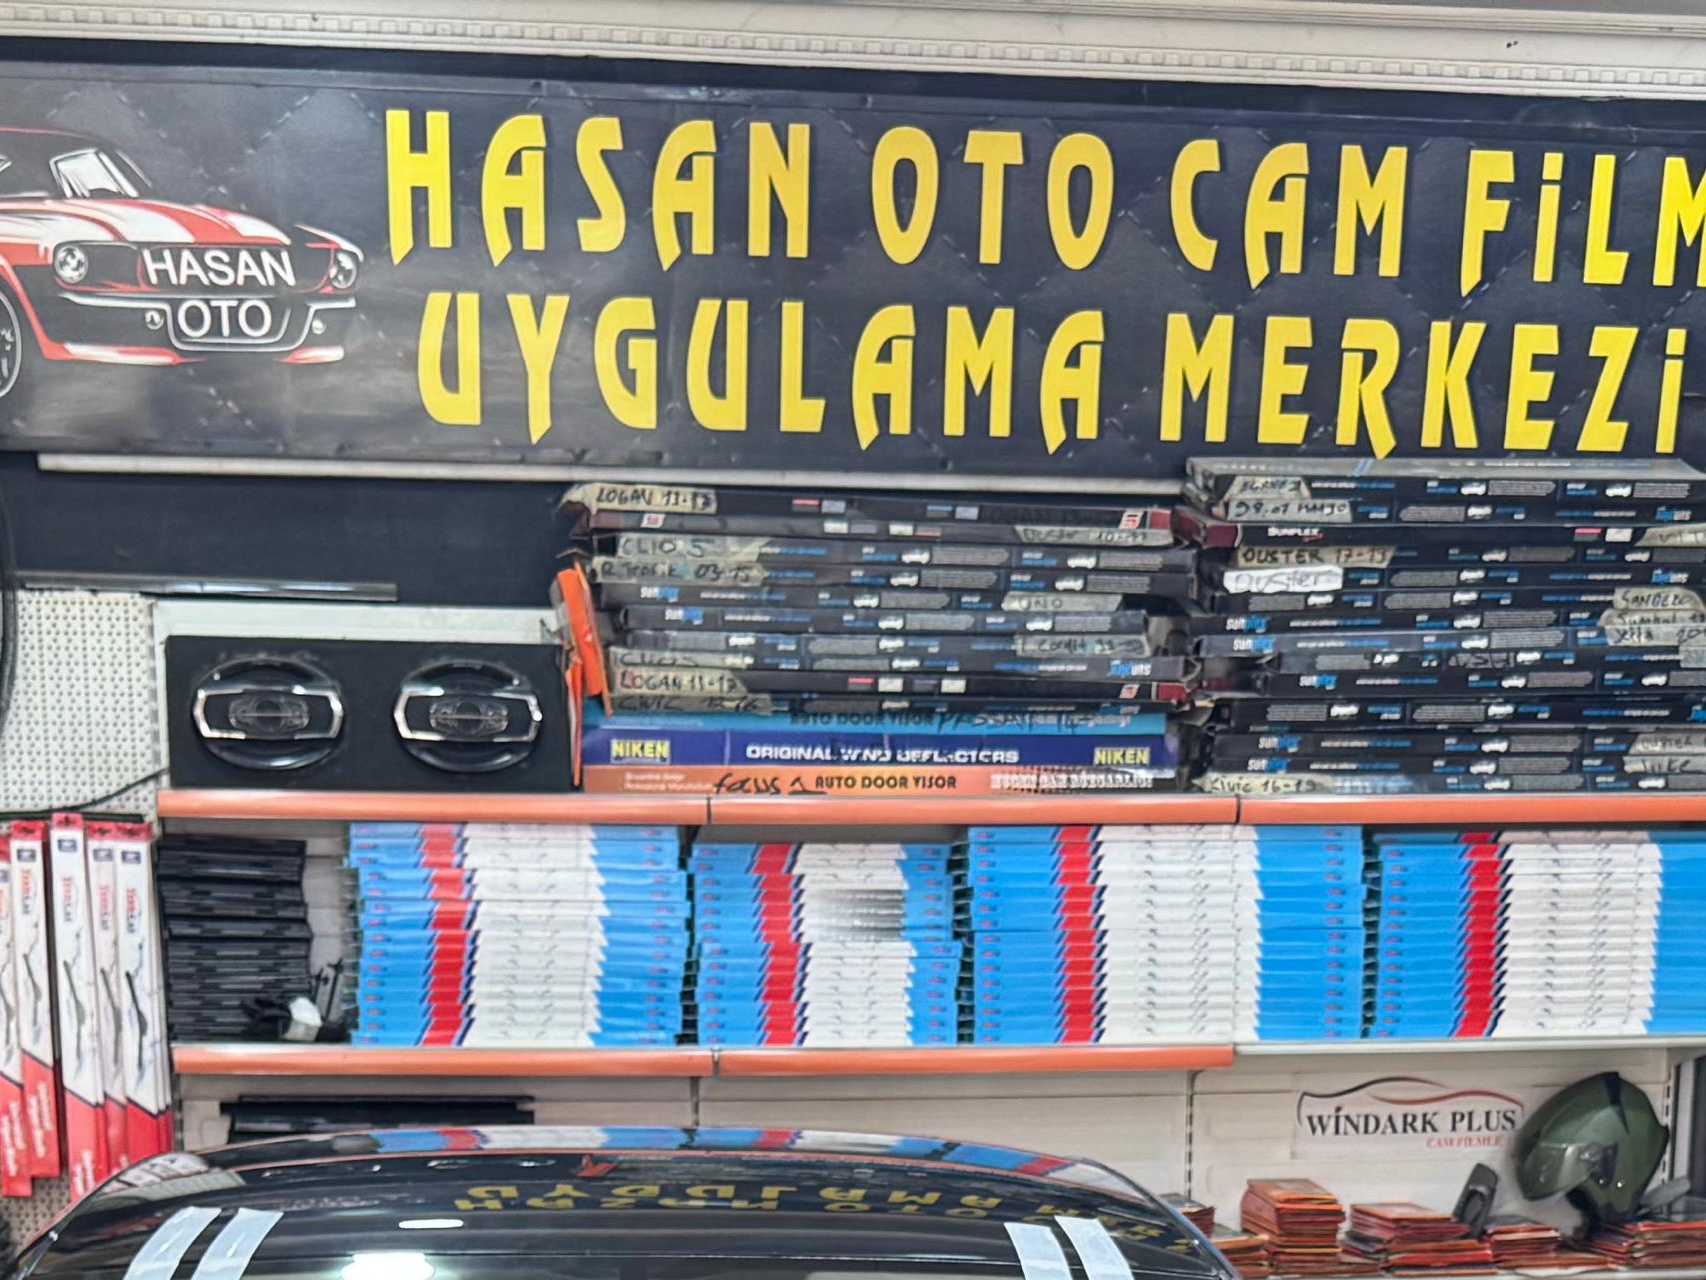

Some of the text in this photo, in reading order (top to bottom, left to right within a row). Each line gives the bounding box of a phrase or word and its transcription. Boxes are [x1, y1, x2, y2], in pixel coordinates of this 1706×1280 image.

[385, 109, 810, 272] HASAN
[872, 126, 1114, 271] OTO
[1170, 140, 1407, 289] CAM
[144, 247, 295, 289] HASAN
[178, 299, 271, 339] OTO
[417, 291, 1104, 454] UYGULAMA
[611, 739, 670, 758] NIKEN
[746, 744, 833, 761] ORIGINAL
[1094, 747, 1150, 765] NIKEN
[815, 775, 958, 790] AUTO DOOR VISOR
[1451, 1109, 1517, 1133] PLUS
